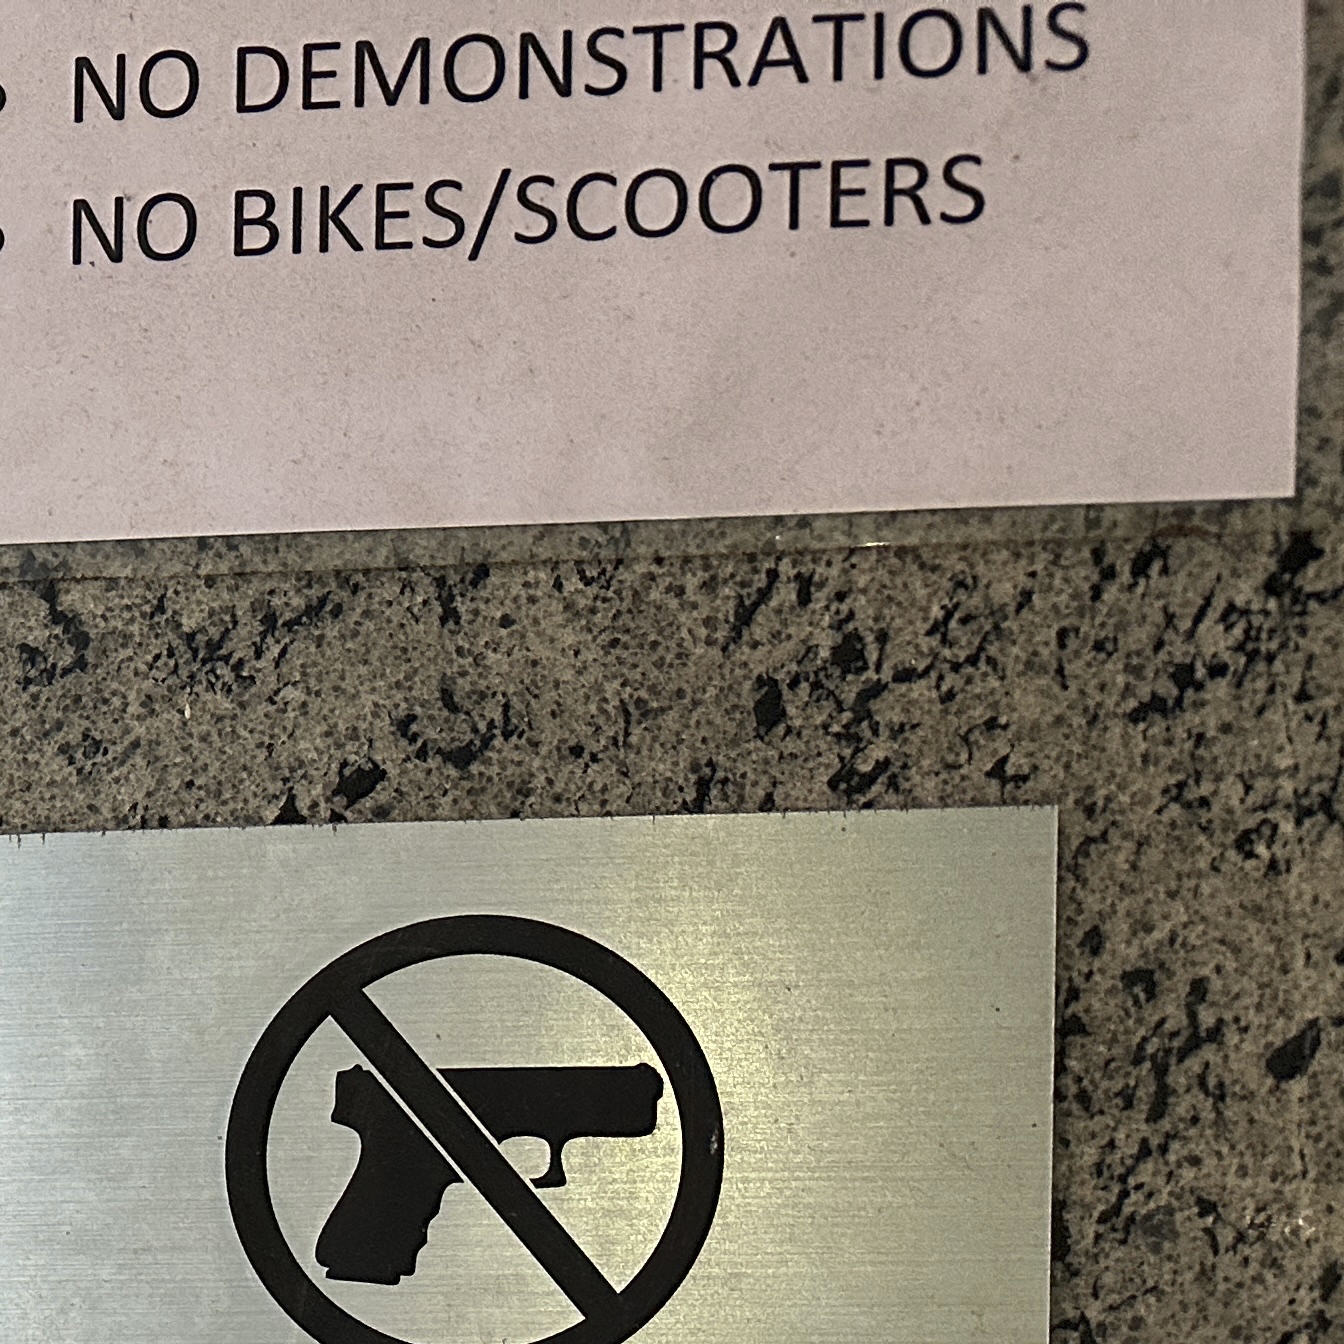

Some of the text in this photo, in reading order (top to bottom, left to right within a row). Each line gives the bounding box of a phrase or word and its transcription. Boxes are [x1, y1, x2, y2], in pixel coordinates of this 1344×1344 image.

[73, 0, 1090, 125] NO DEMONSTRATIONS
[72, 152, 987, 267] NO BIKES/SCOOTERS
